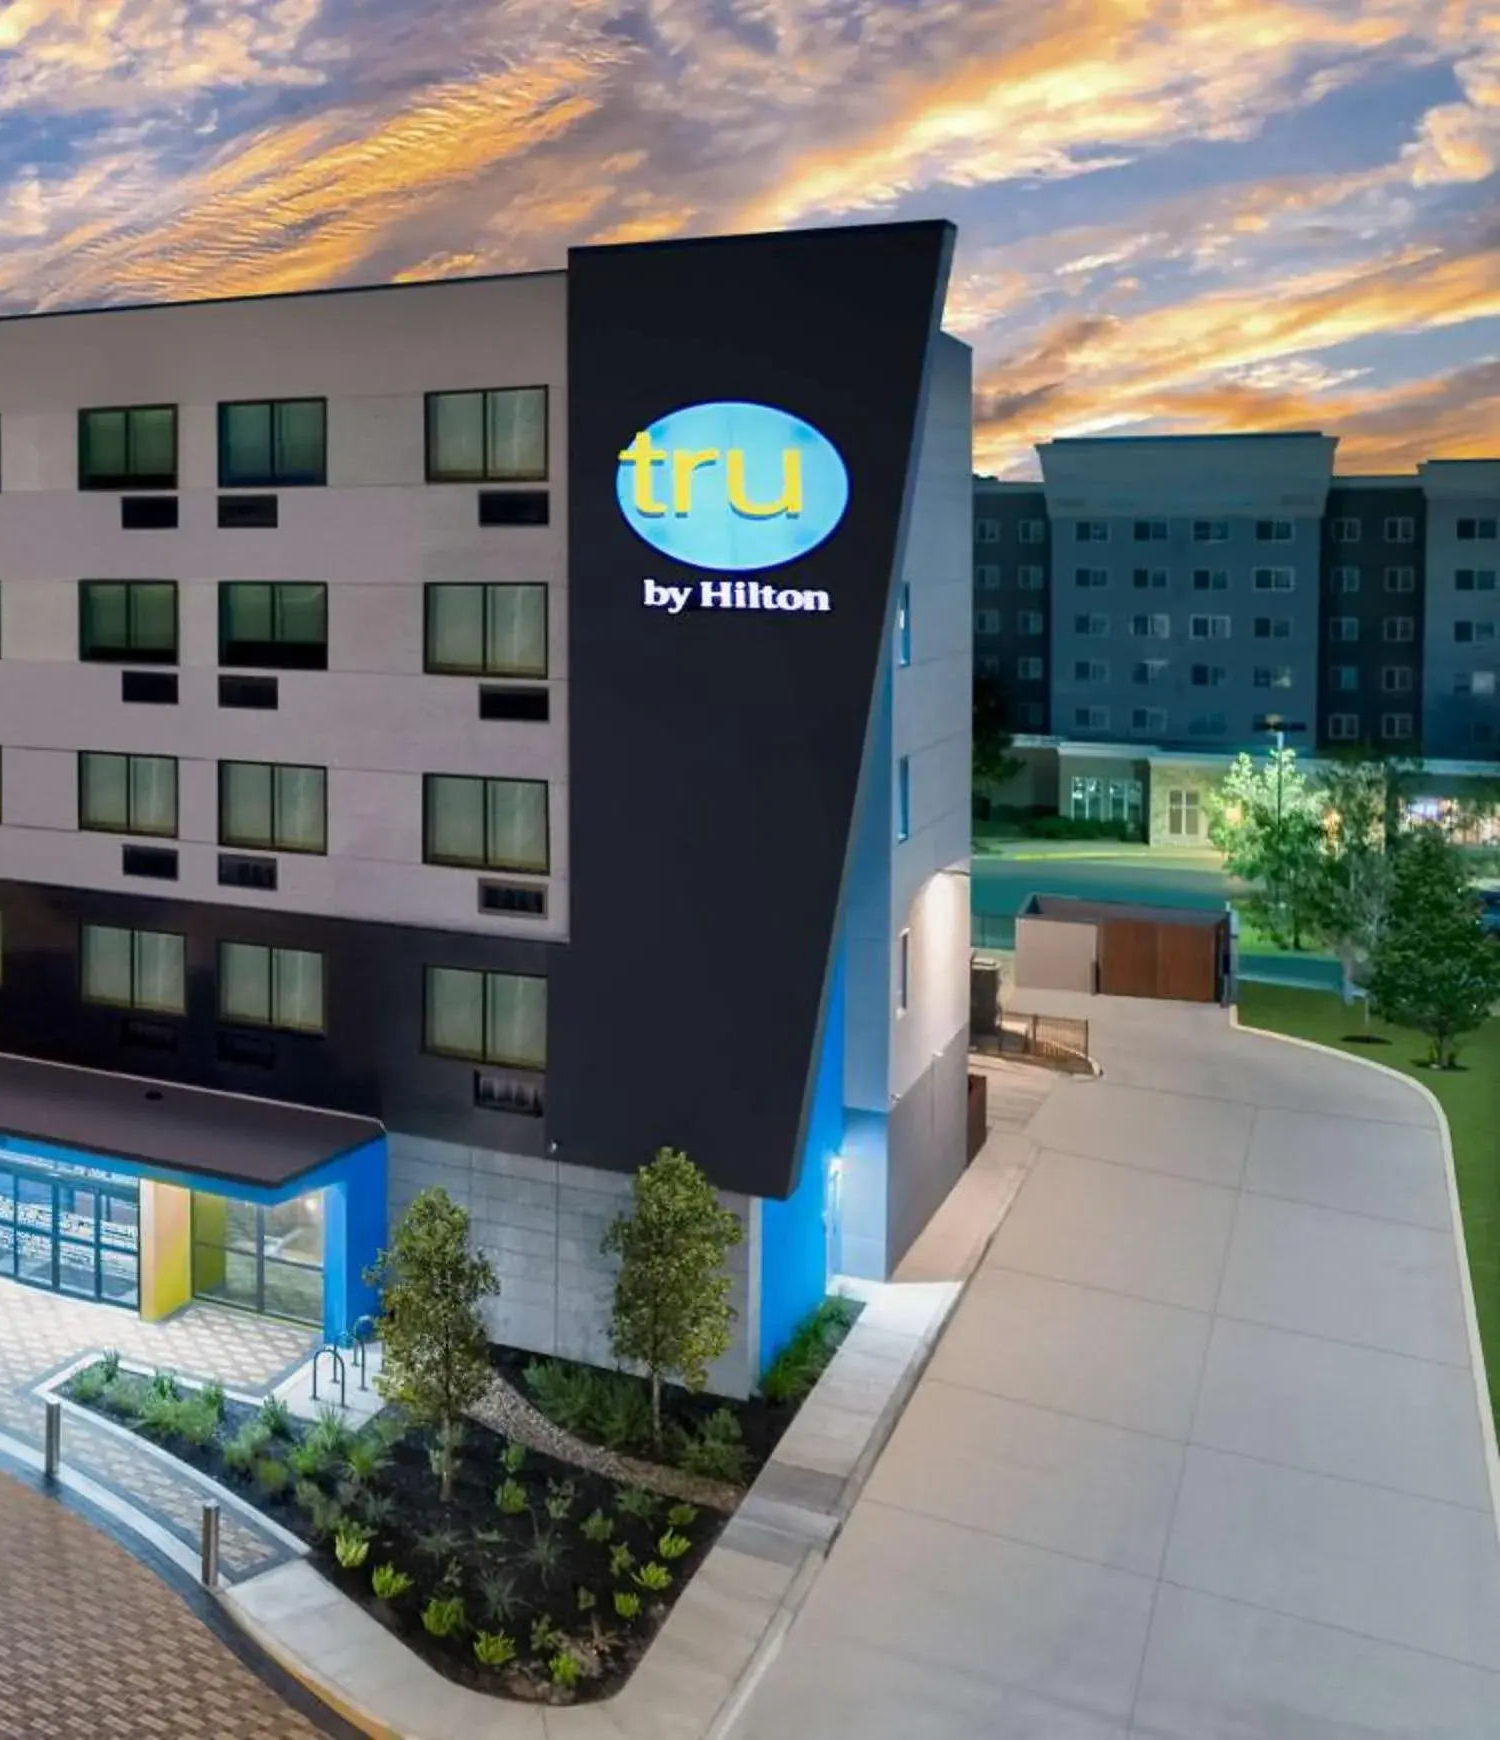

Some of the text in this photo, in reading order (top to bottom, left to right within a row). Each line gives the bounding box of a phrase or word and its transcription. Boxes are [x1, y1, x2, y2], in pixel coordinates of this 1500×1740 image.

[618, 431, 803, 517] tru
[643, 579, 831, 613] by Hilton
